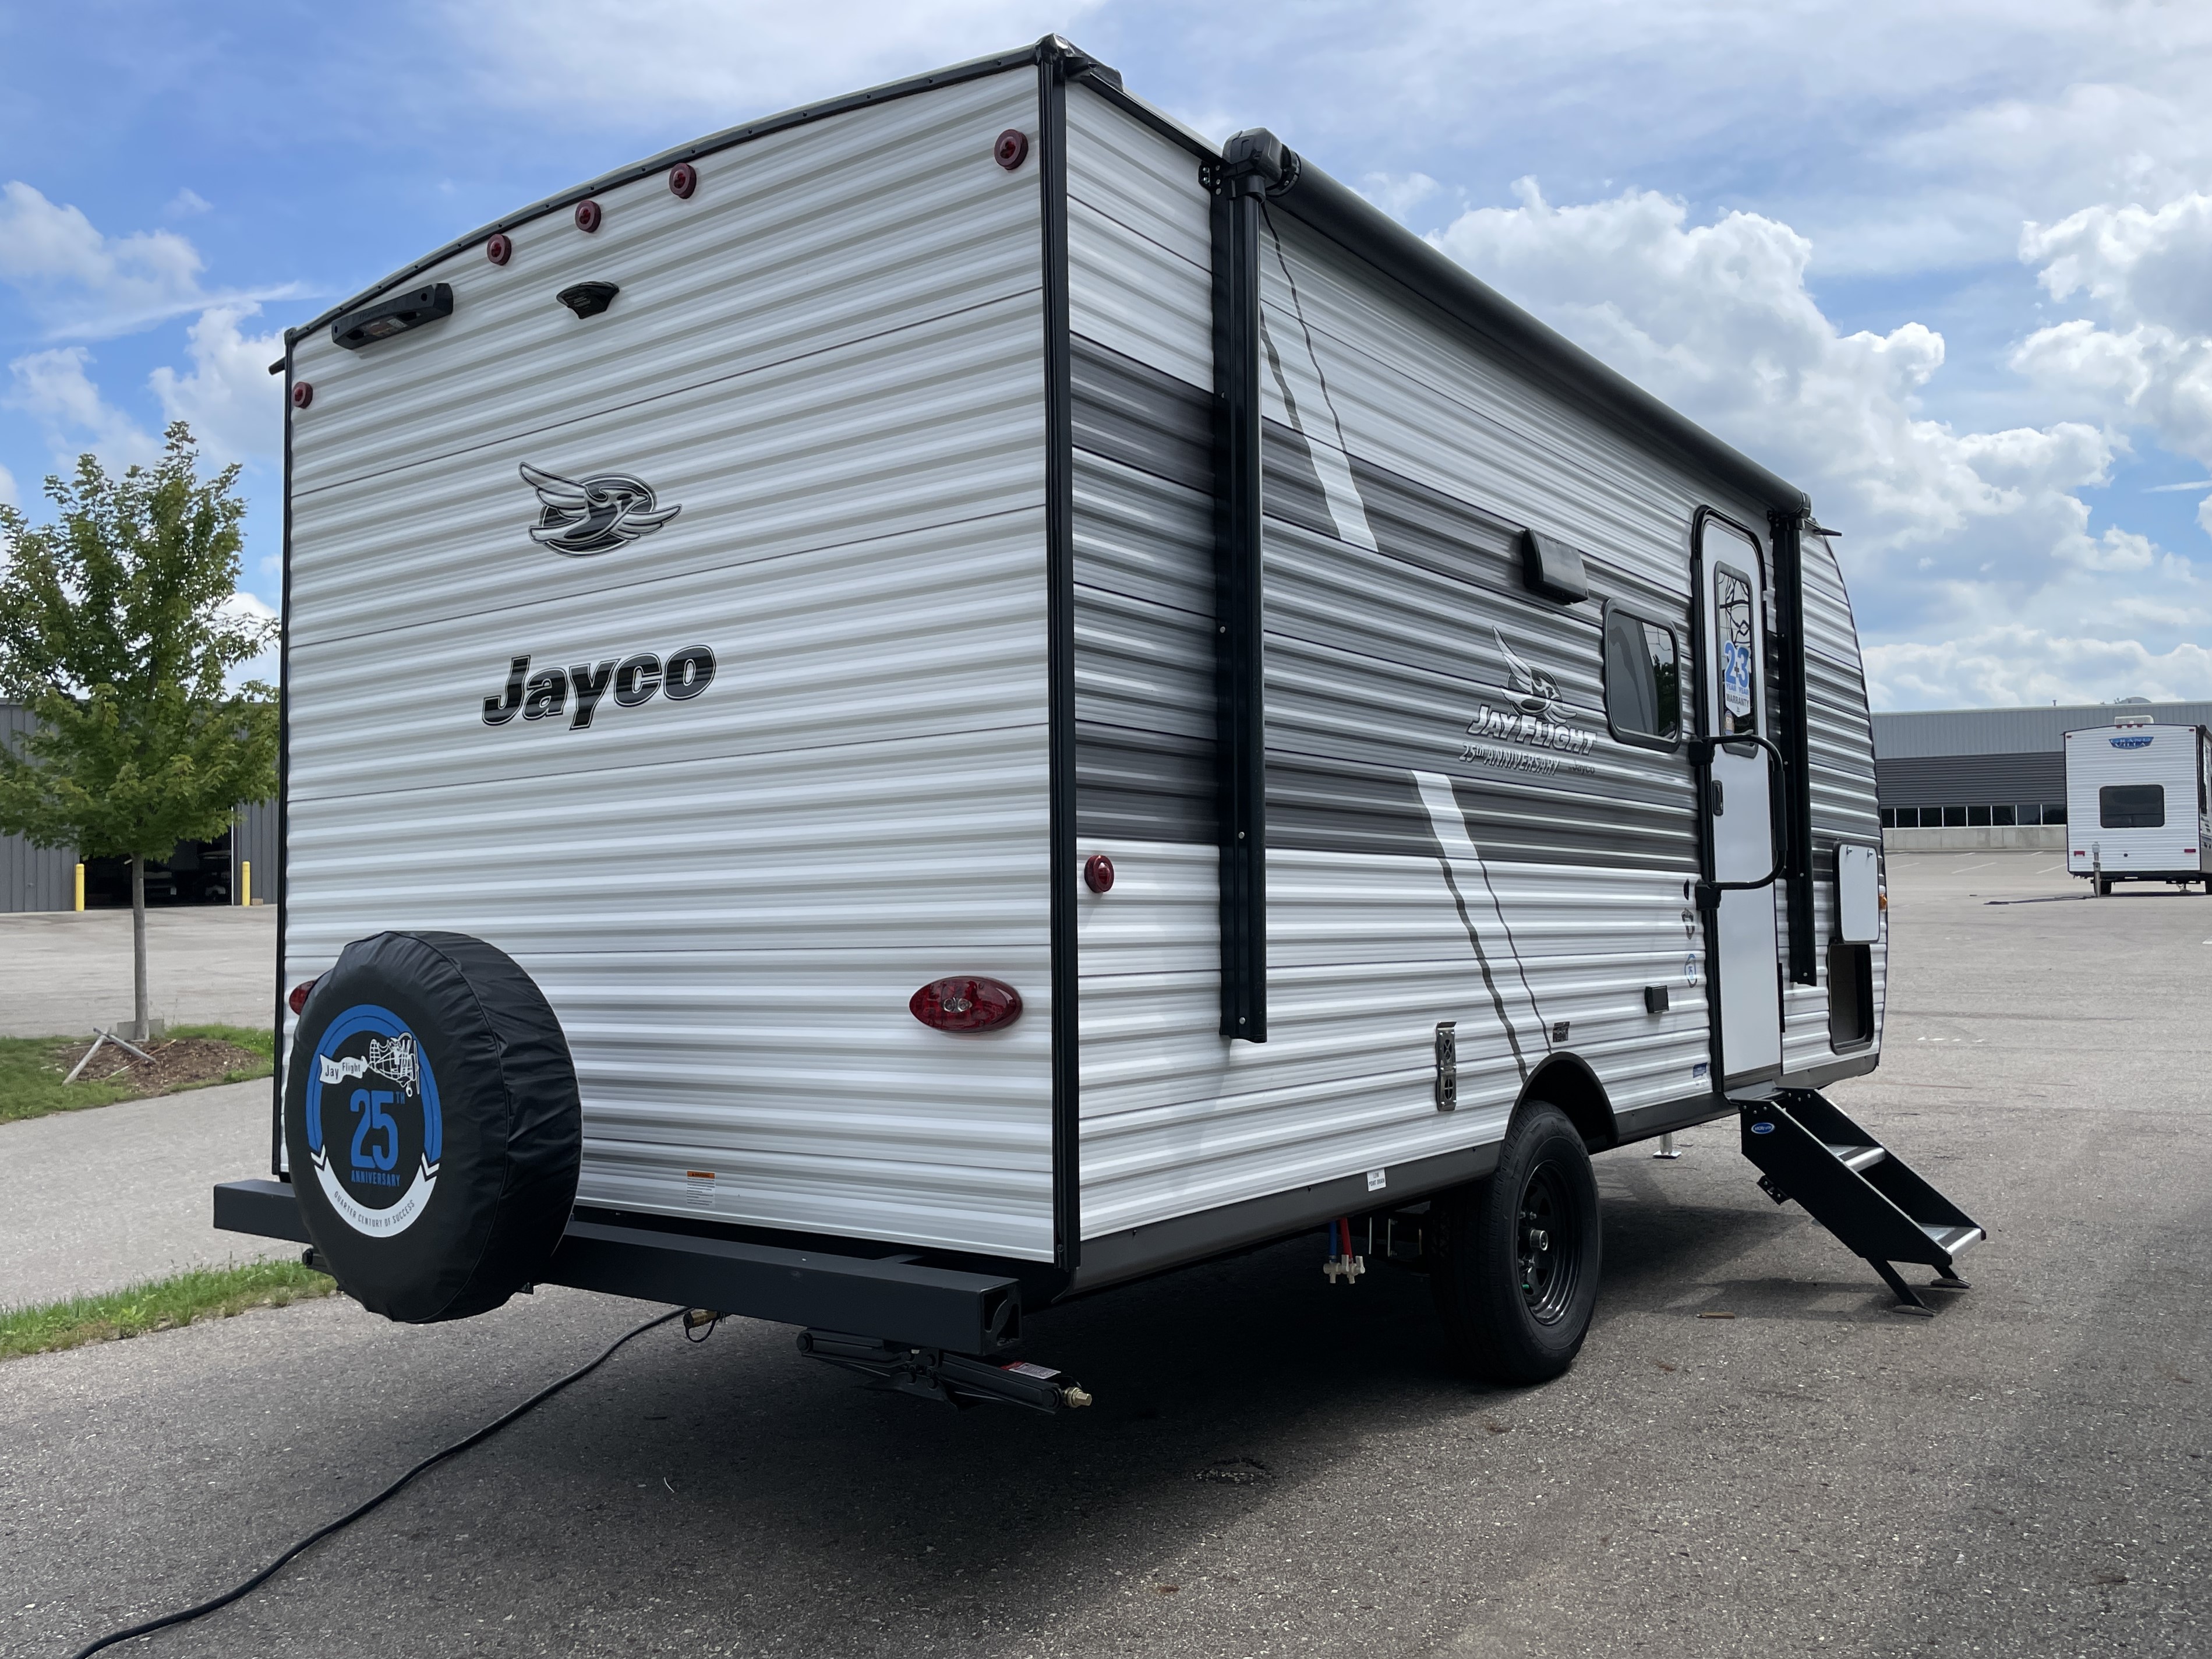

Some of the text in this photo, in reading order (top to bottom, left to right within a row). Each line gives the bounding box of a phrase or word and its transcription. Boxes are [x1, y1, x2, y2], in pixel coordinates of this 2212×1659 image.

[482, 644, 717, 730] Jayco
[1726, 683, 1749, 696] YEAR YEAR
[1726, 693, 1750, 707] WARRANTY
[1467, 704, 1598, 755] JAY FLIGHT
[1459, 742, 1560, 775] 25th ANNIVERSARY
[325, 1063, 361, 1080] Jay Flight
[351, 1170, 401, 1187] ANNIVERSARY
[334, 1191, 356, 1219] QUARTER
[358, 1213, 383, 1228] CENTURY
[393, 1199, 415, 1224] SUCCESS
